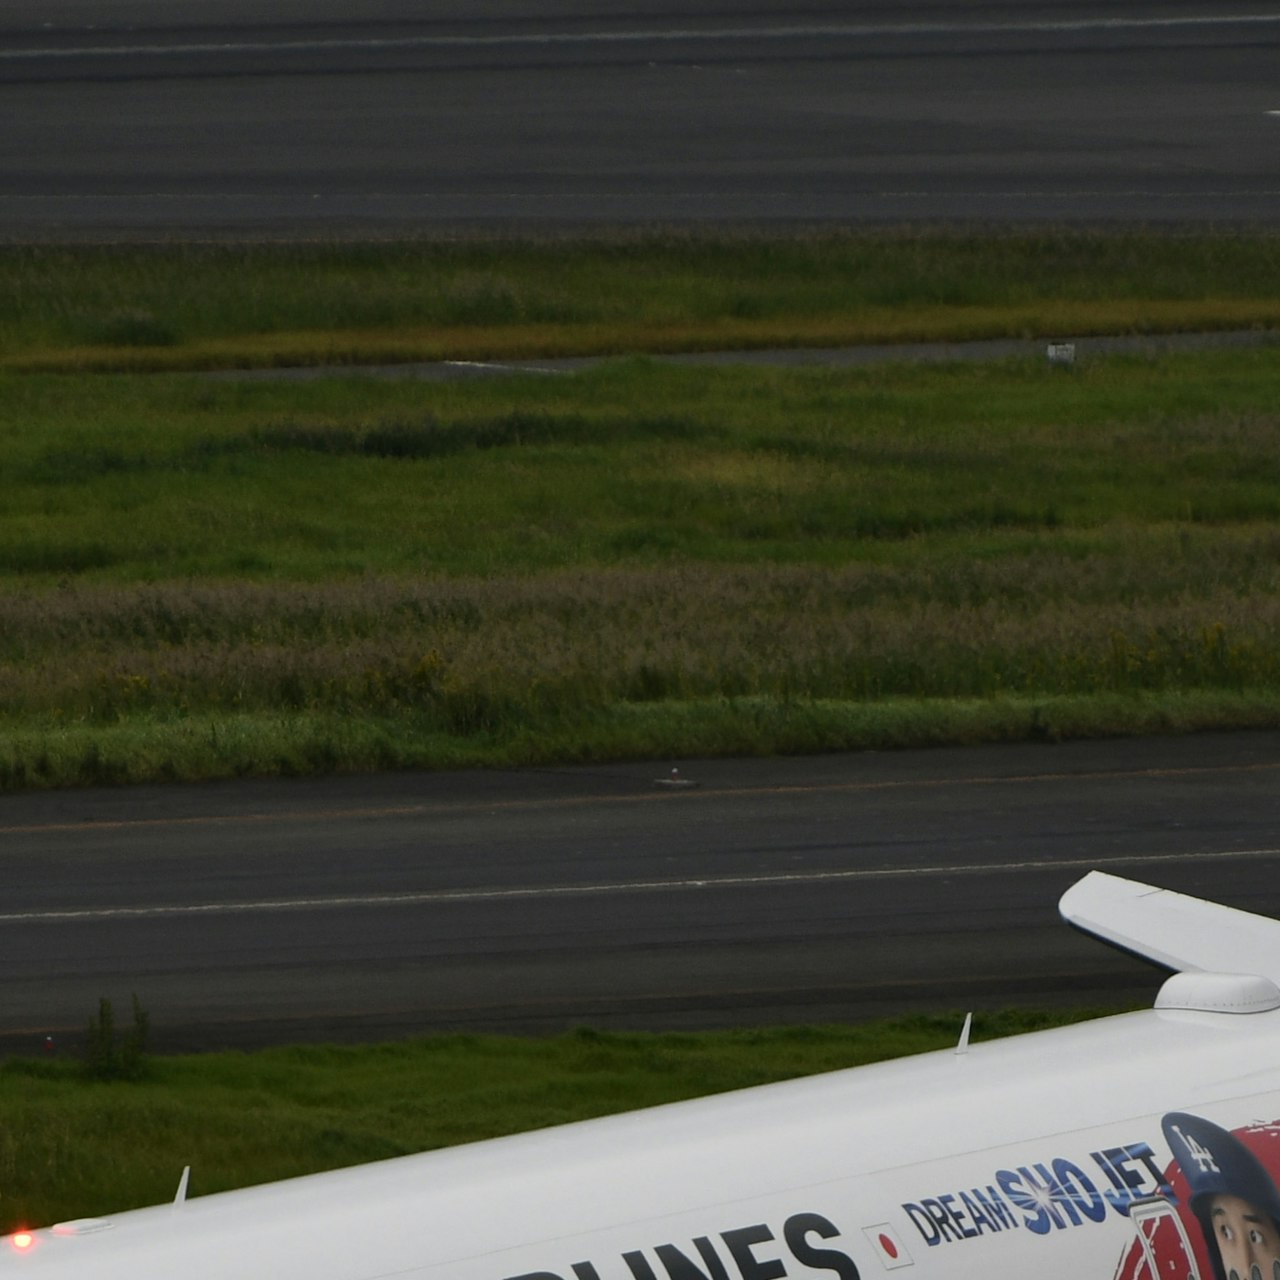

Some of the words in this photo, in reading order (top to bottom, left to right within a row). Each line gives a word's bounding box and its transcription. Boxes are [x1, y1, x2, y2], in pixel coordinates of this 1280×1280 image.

[1170, 1125, 1221, 1173] LA
[902, 1186, 1018, 1247] DREAM
[995, 1158, 1106, 1235] SHO
[1089, 1142, 1179, 1217] JET
